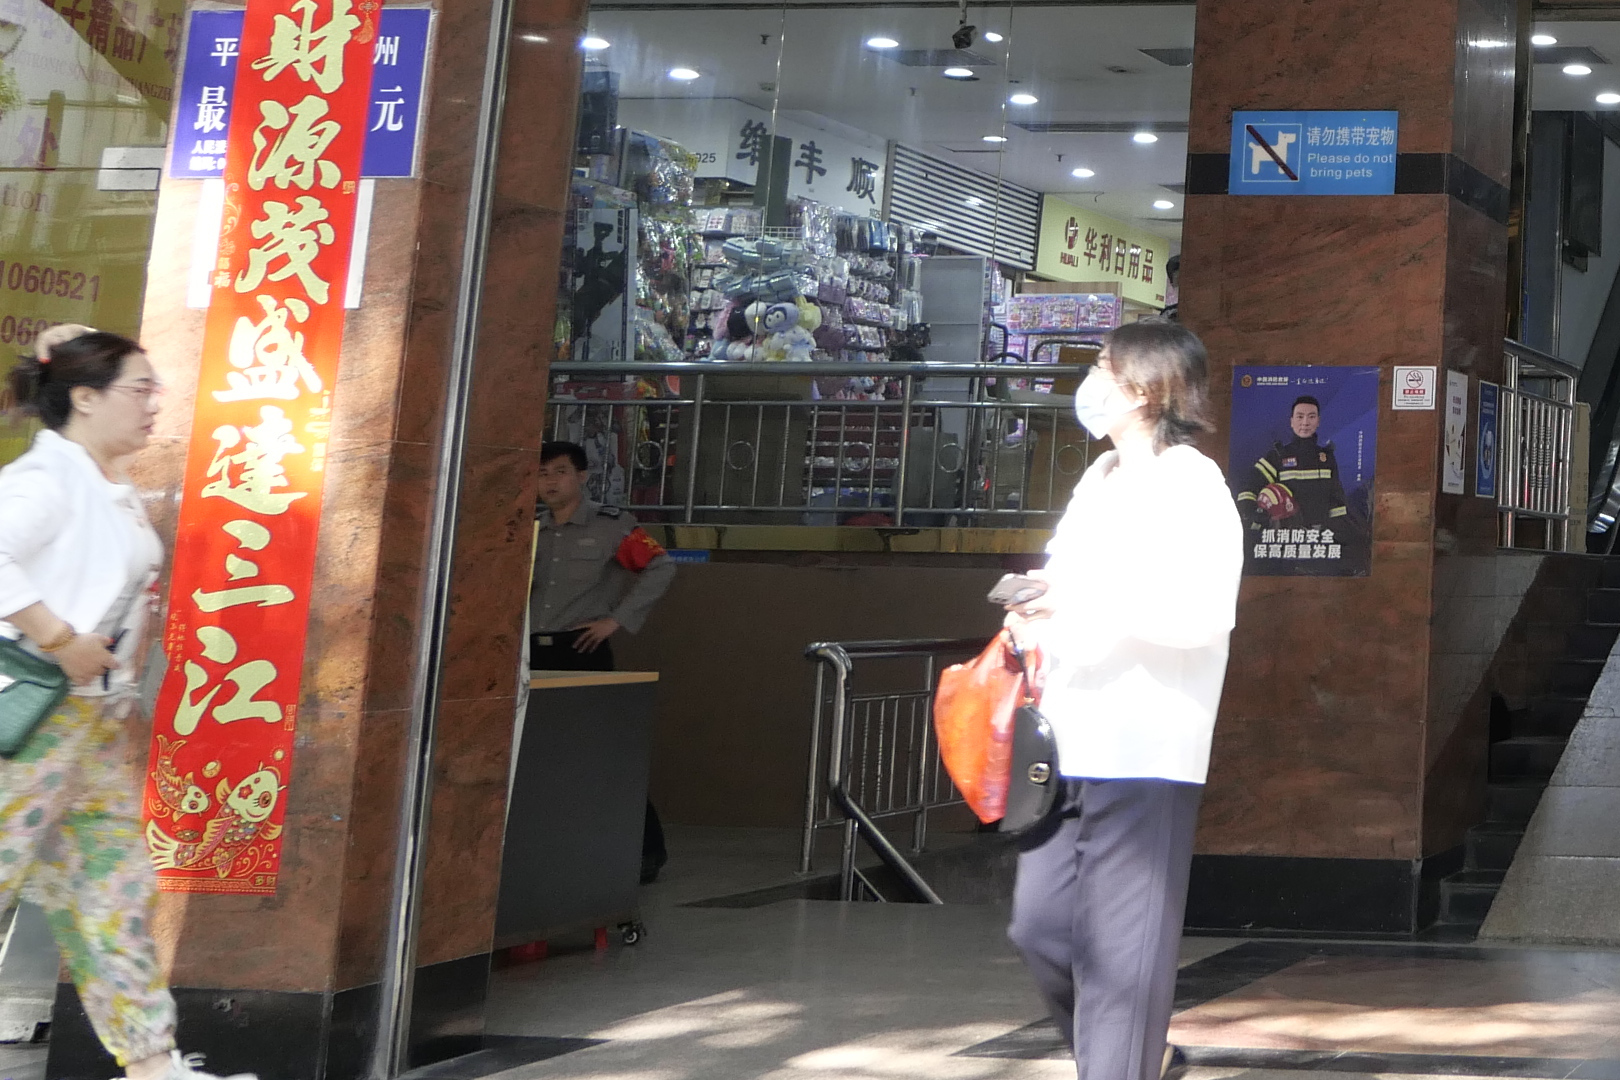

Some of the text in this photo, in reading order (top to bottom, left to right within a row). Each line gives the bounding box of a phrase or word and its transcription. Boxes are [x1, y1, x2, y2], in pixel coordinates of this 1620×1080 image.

[210, 37, 239, 67] 平
[193, 85, 405, 134] 最 元
[1307, 126, 1395, 147] 请勿携带宠物
[1307, 153, 1393, 164] Please do not
[1310, 168, 1373, 180] bring pets
[1083, 226, 1154, 285] 华利日用品
[1262, 529, 1335, 544] 抓消防安全
[1253, 544, 1342, 559] 保高质量发展
